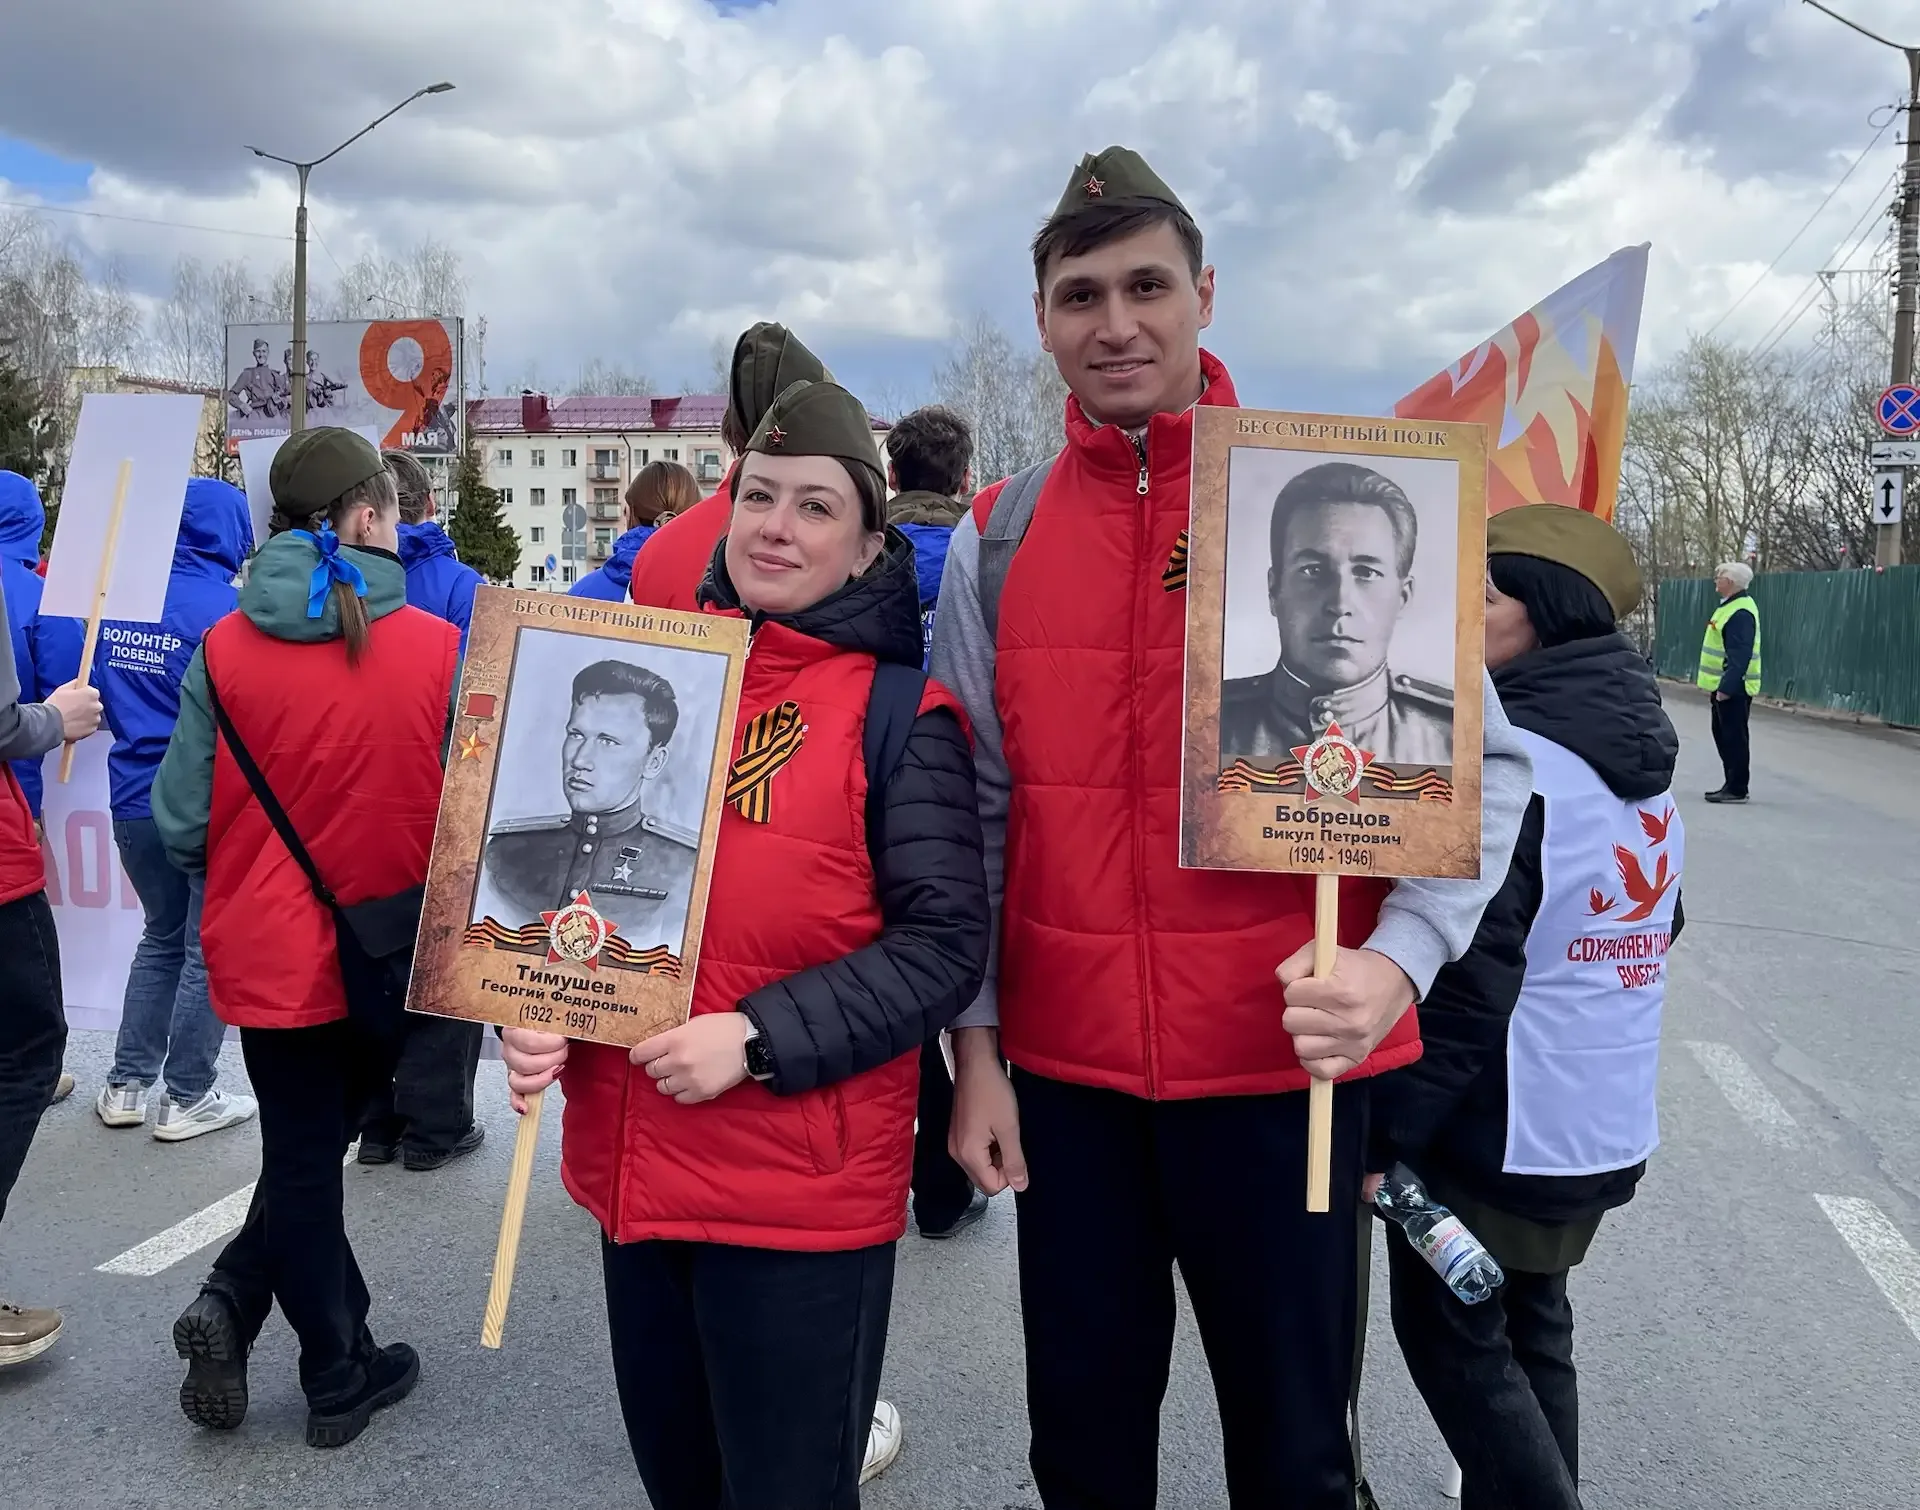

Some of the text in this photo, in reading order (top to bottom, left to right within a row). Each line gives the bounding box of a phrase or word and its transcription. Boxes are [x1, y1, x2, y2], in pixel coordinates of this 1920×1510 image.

[359, 320, 452, 450] 9
[231, 428, 253, 437] ДЕНЬ
[401, 431, 439, 447] МАЯ
[1237, 417, 1448, 446] БЕССМЕРТНЫЙ ПОЛК
[513, 598, 711, 638] БЕССМЕРТНЫЙ ПОЛК
[103, 626, 181, 652] ВОЛОНТЁР
[112, 644, 165, 665] ПОБЕДЫ
[1275, 805, 1391, 828] Бобрецов
[1262, 826, 1401, 846] Викул Петрович
[1288, 846, 1325, 867] (1904
[1338, 848, 1374, 870] 1946)
[1567, 933, 1654, 963] СОХРАНЯЕМ
[516, 964, 617, 996] Тимушев
[480, 978, 639, 1016] Георгий Федорович
[519, 1003, 554, 1024] (1922
[564, 1009, 598, 1035] 1997)
